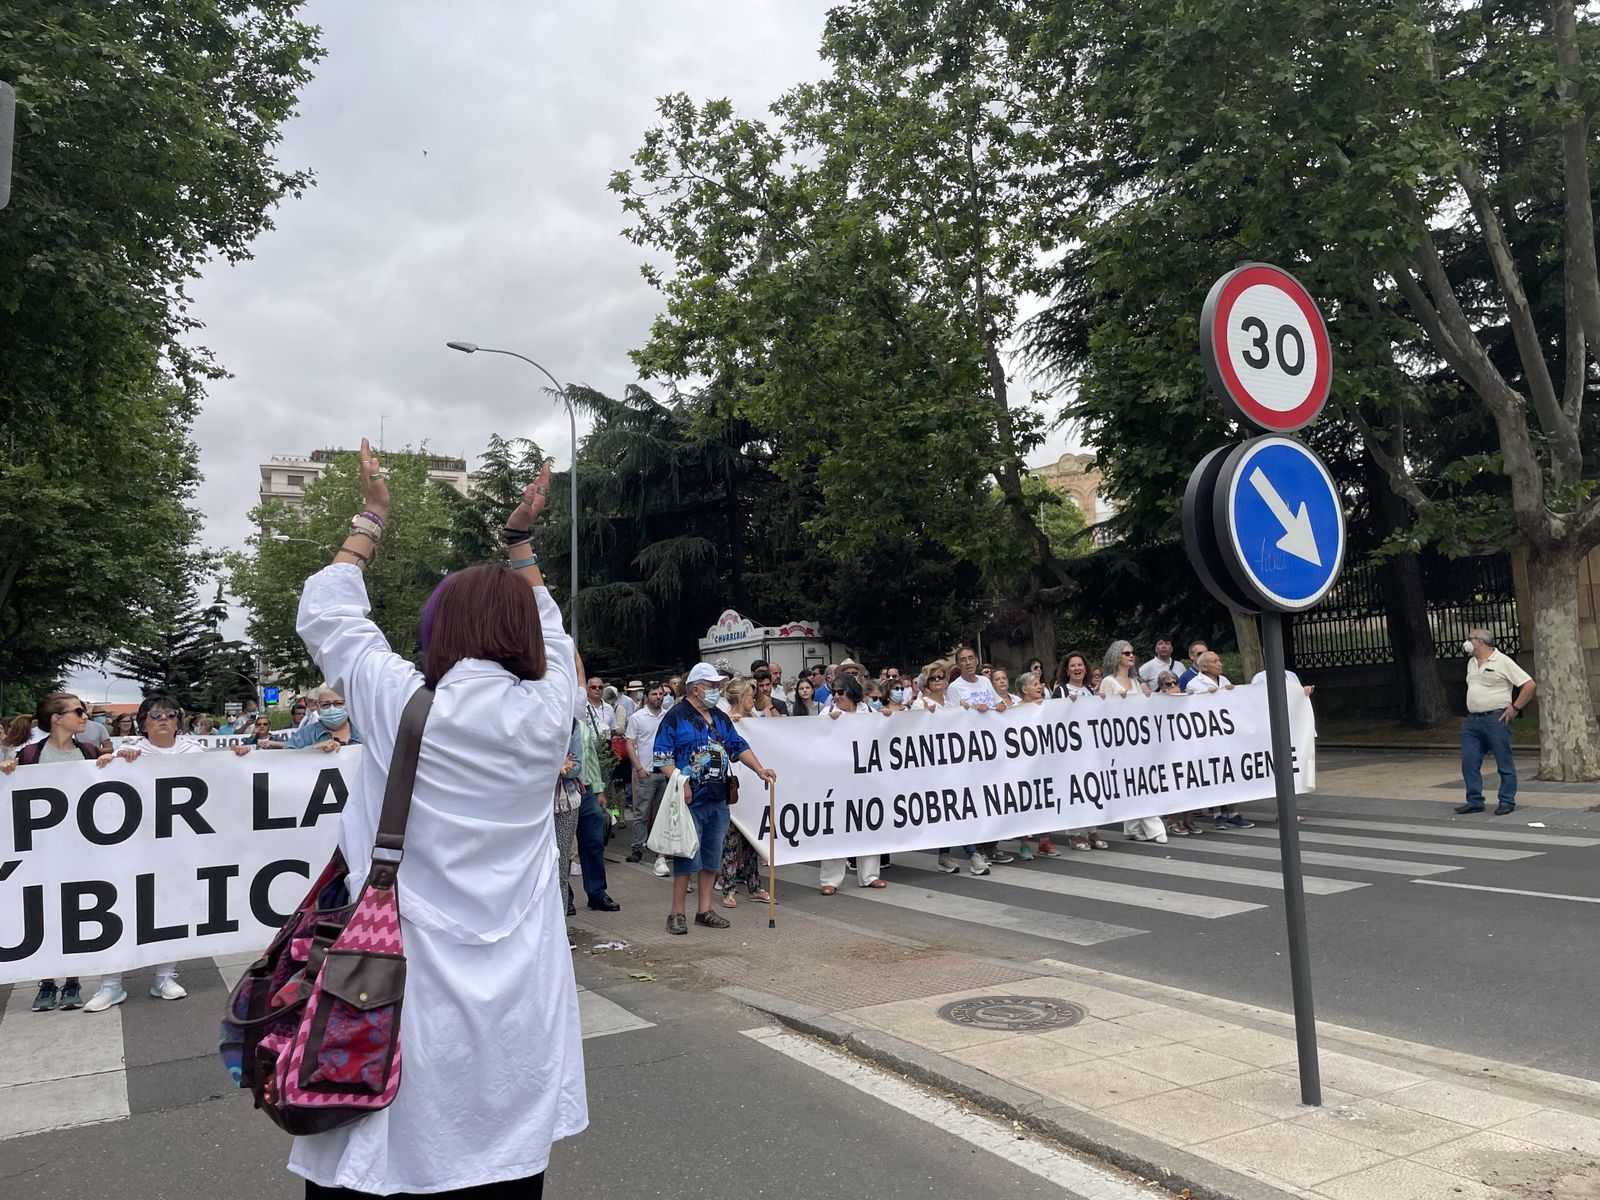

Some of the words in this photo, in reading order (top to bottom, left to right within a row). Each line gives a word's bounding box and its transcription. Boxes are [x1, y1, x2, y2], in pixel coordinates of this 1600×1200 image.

[1241, 316, 1305, 376] 30
[852, 739, 883, 774] LA
[889, 730, 998, 771] SANIDAD
[1004, 720, 1083, 759] SOMOS
[1087, 715, 1150, 749] TODOS
[1154, 714, 1163, 743] Y
[1167, 708, 1235, 742] TODAS
[11, 775, 217, 852] POR
[253, 767, 349, 831] LA
[757, 789, 835, 848] AQUÍ
[845, 796, 885, 833] NO
[893, 788, 979, 829] SOBRA
[983, 777, 1062, 815] NADIE,
[1069, 758, 1121, 810] AQUÍ
[1123, 763, 1169, 798] HACE
[1172, 755, 1236, 790] FALTA
[1240, 746, 1300, 781] GENE
[0, 858, 311, 963] ÚBLIC
